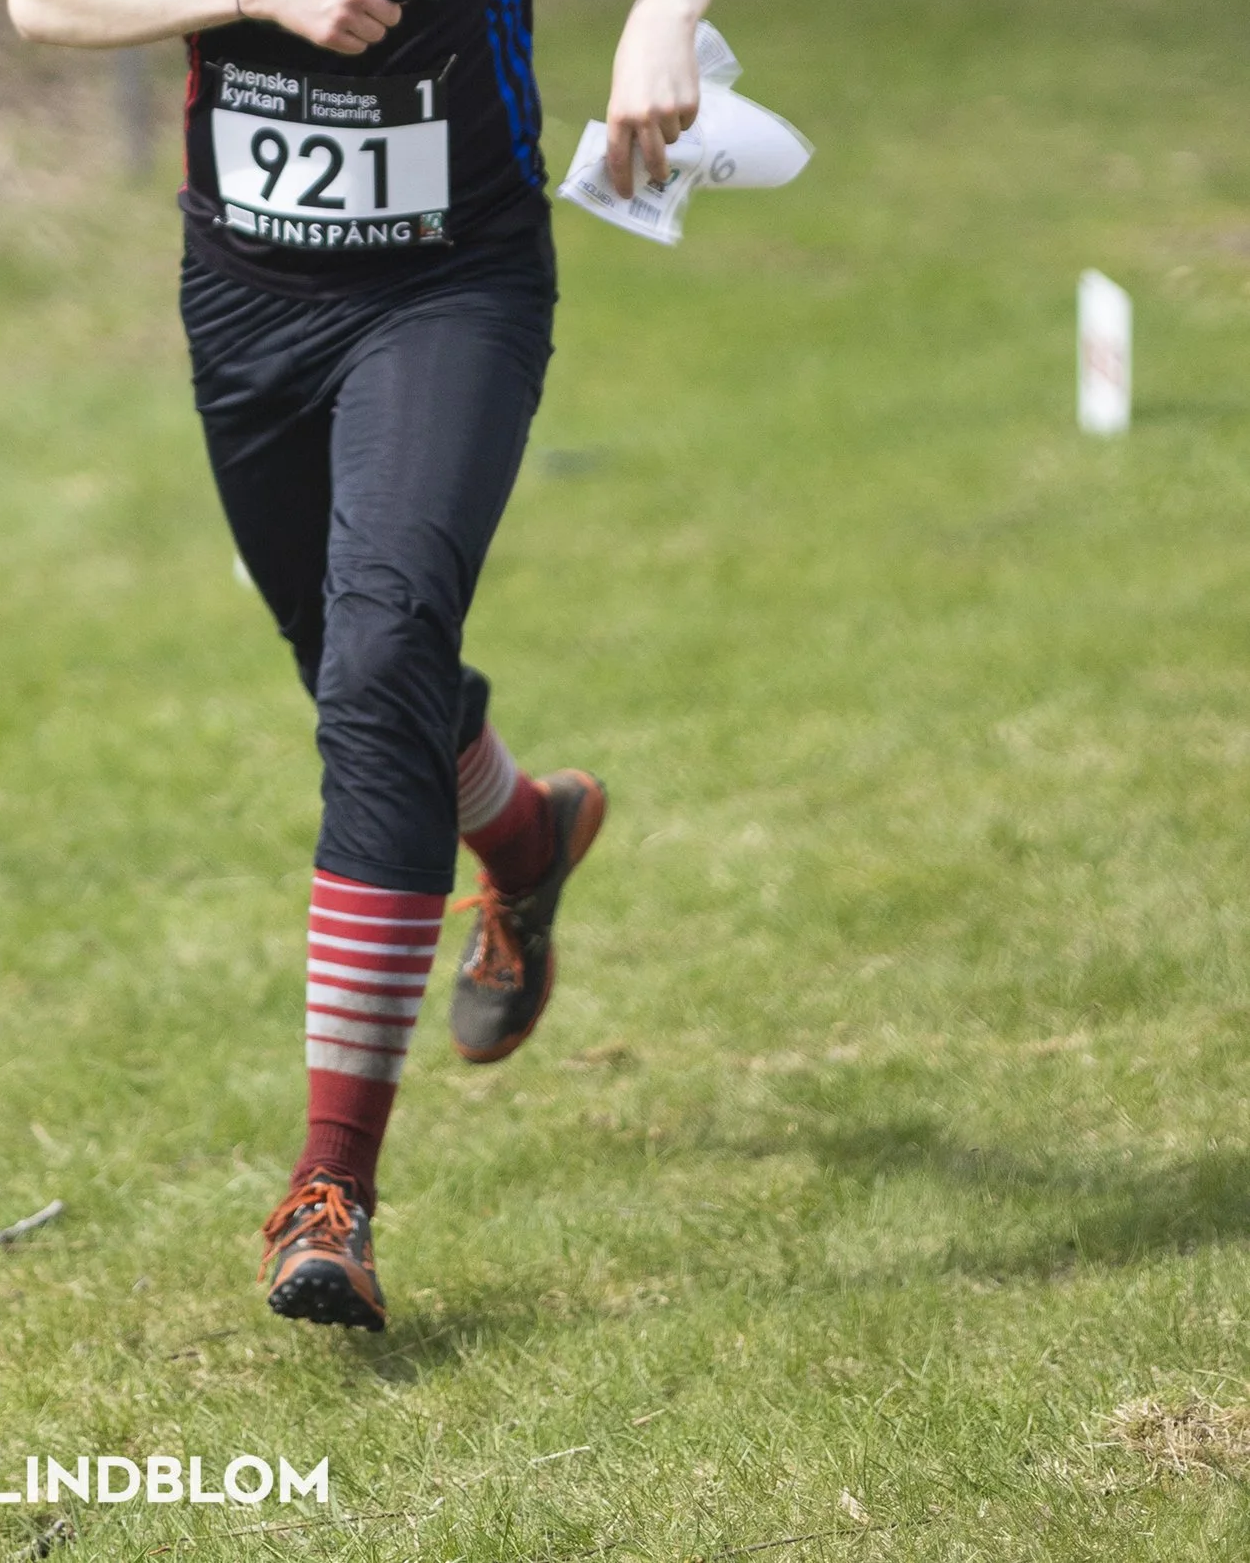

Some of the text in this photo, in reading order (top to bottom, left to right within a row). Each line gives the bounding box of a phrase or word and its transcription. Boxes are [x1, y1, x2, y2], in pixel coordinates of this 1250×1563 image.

[222, 62, 300, 95] Svenska
[221, 81, 286, 111] kyrkan
[311, 88, 378, 108] Finspångs
[414, 78, 434, 119] 1
[310, 103, 382, 123] församling
[250, 126, 389, 210] 921
[257, 214, 413, 245] FINSPÅNG
